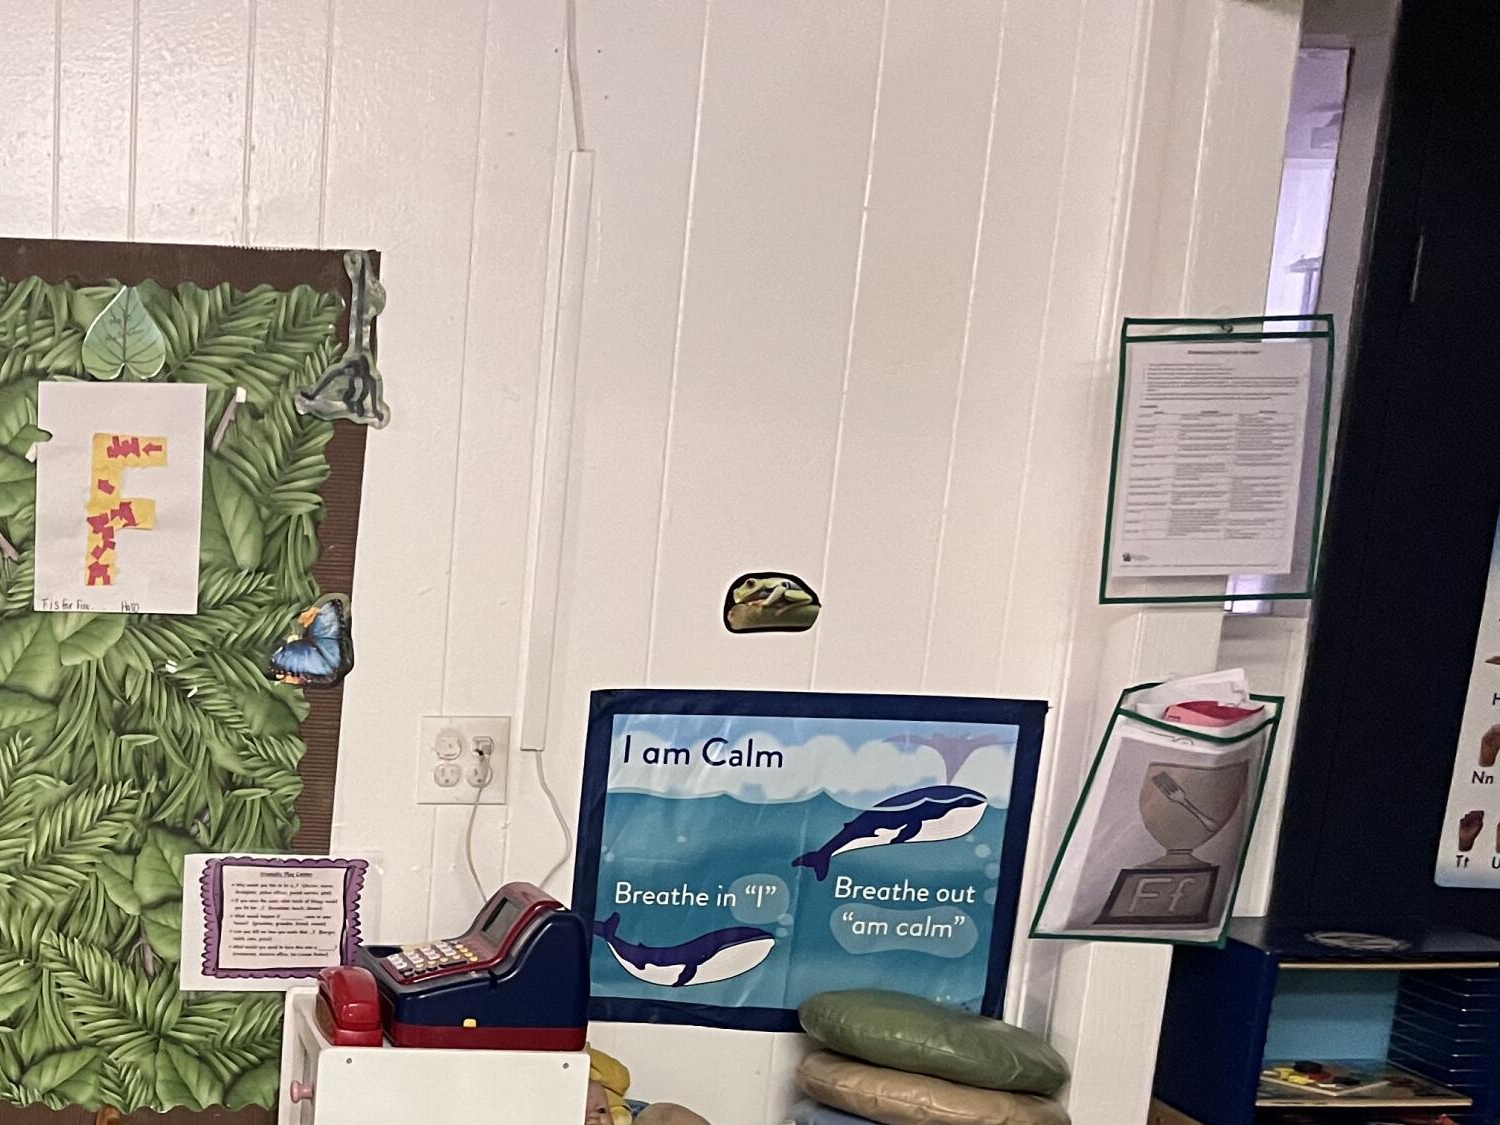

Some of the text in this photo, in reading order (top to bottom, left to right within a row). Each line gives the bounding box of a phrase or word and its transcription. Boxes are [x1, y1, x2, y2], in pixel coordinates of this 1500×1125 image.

[623, 735, 784, 768] I am Calm
[1471, 771, 1494, 784] Nn
[615, 882, 710, 908] Breathe
[716, 890, 737, 908] in
[834, 877, 976, 905] Breathe out
